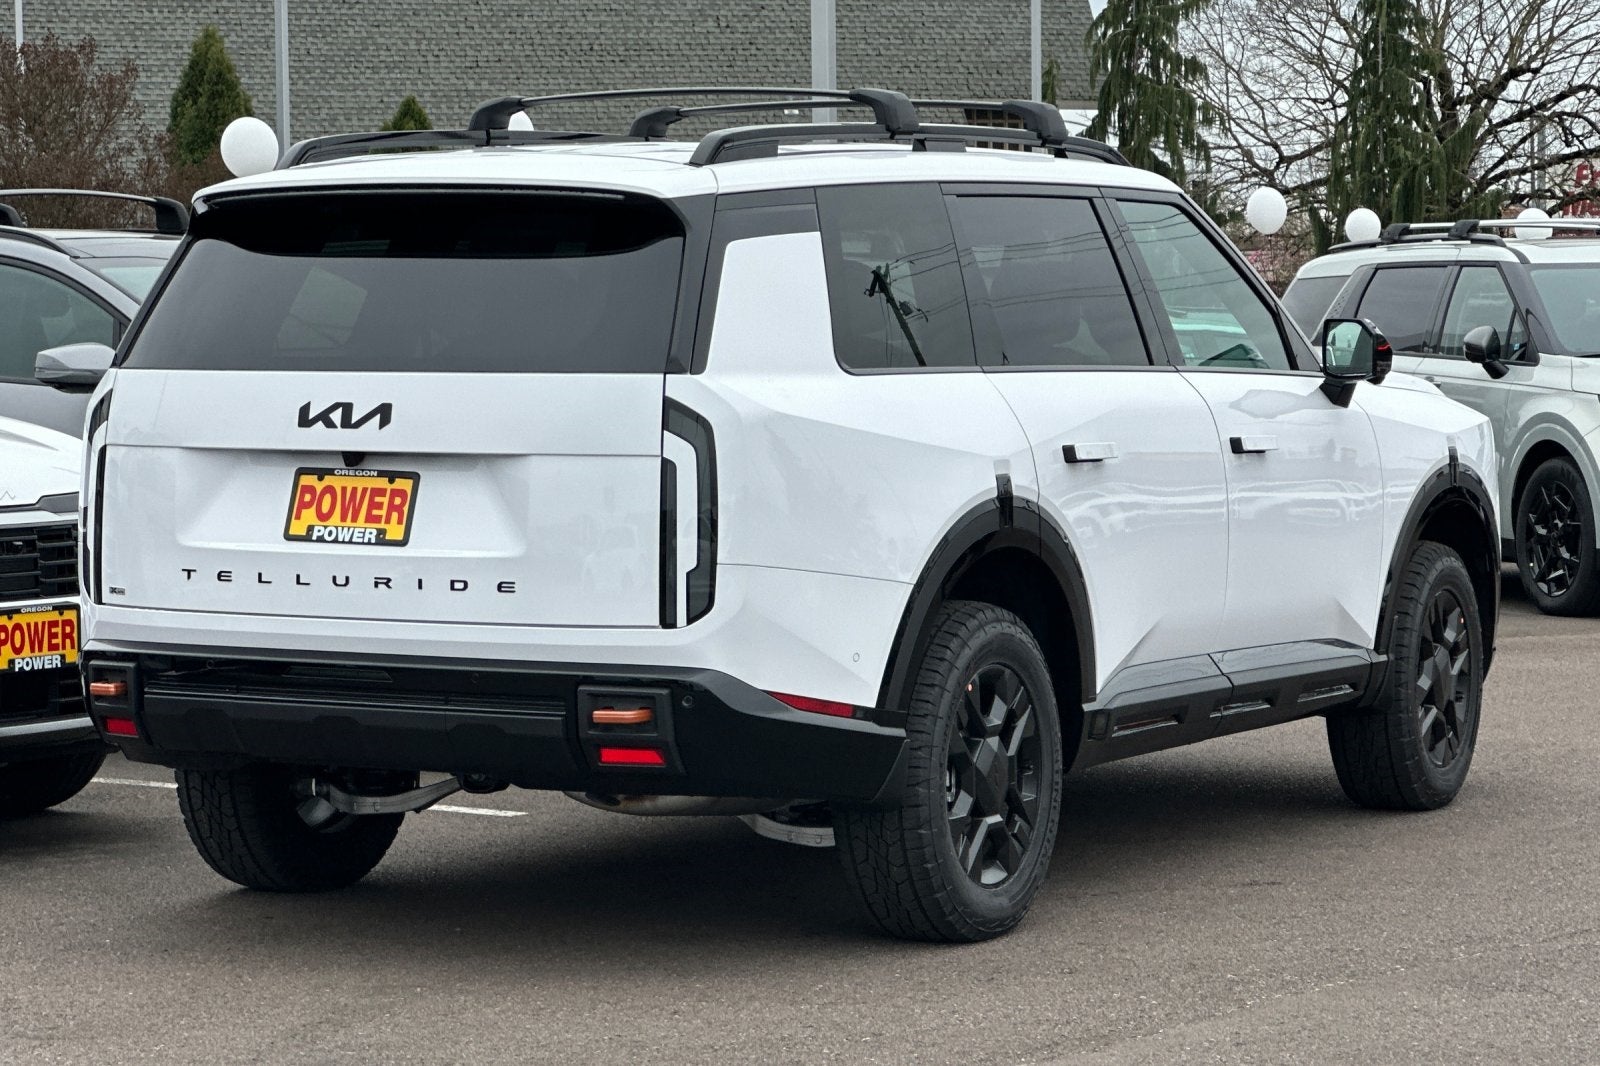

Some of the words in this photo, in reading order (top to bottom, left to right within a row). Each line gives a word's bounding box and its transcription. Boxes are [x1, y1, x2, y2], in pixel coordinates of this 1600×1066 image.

[298, 400, 392, 430] KIA
[334, 469, 378, 477] OREGON
[294, 485, 408, 525] POWER
[312, 526, 377, 543] POWER
[181, 568, 516, 593] TELLURIDE
[0, 619, 76, 656] POWER
[15, 655, 61, 672] POWER
